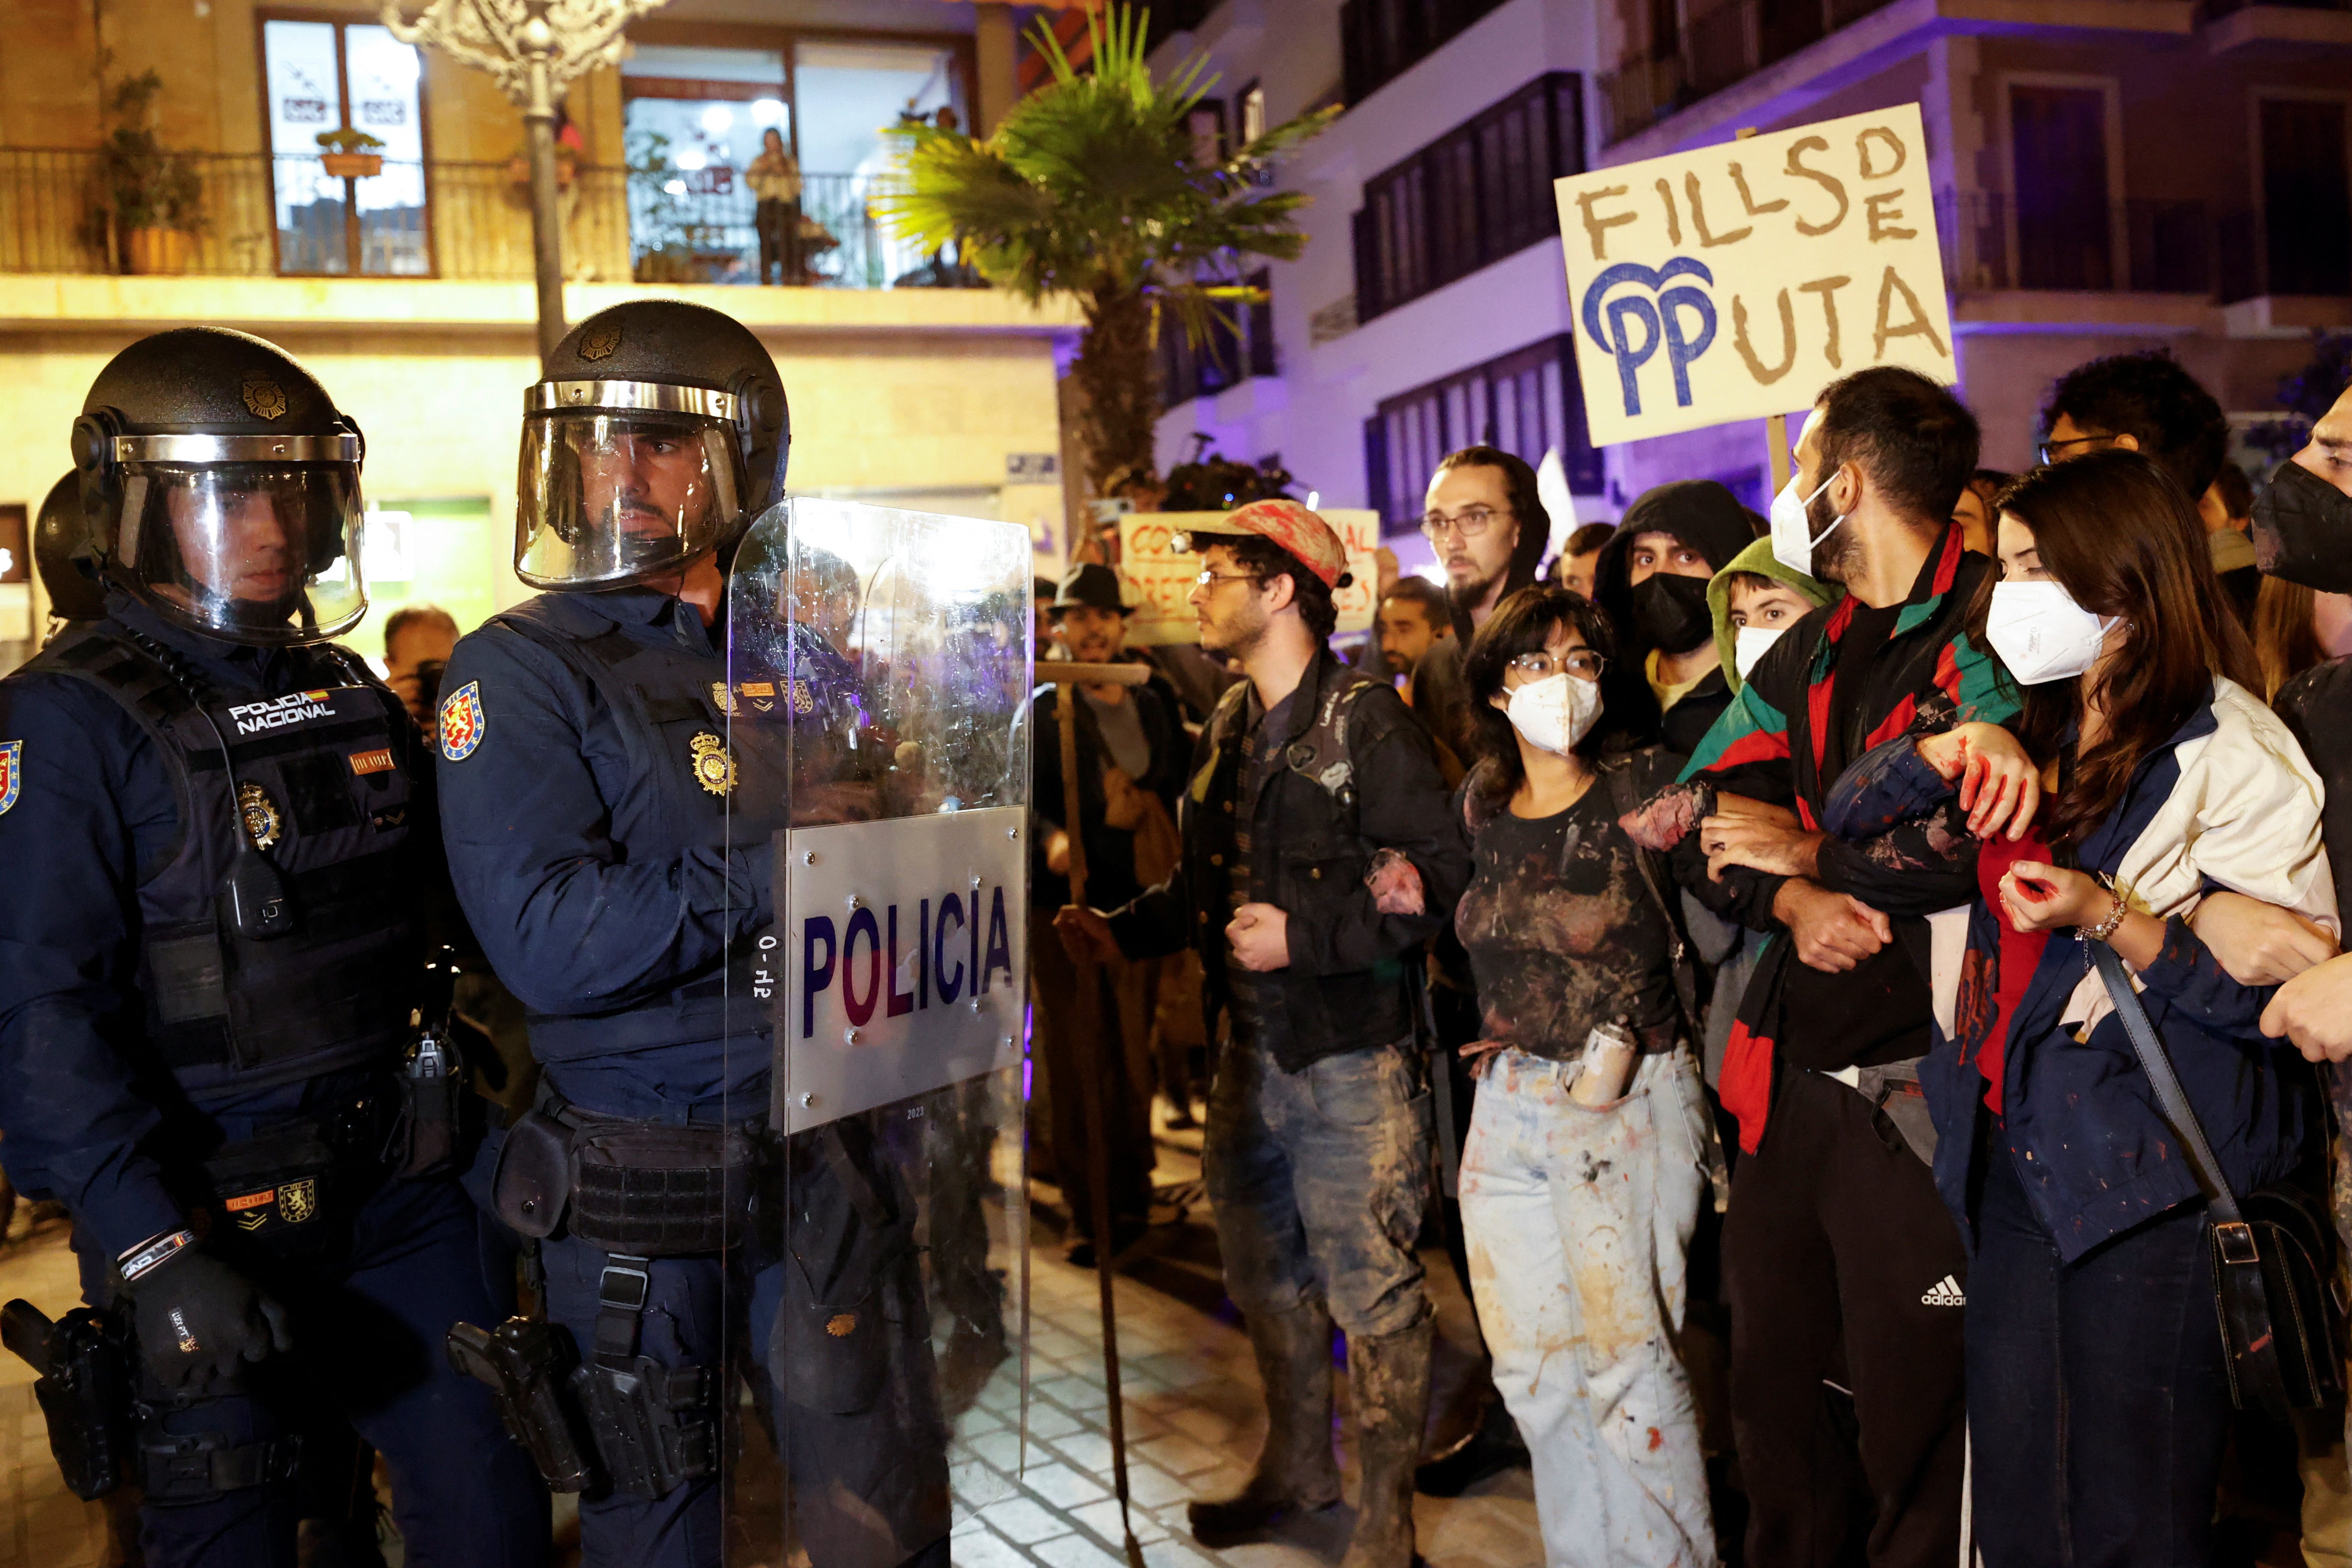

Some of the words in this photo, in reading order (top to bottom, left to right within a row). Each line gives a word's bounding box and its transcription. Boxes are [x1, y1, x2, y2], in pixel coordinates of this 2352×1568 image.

[1575, 135, 1849, 260] FILLS
[1856, 126, 1918, 243] DE
[228, 692, 314, 720] POLICIA
[236, 703, 336, 735] NACIONAL
[907, 1106, 924, 1120] 2023
[126, 1256, 153, 1277] CNP
